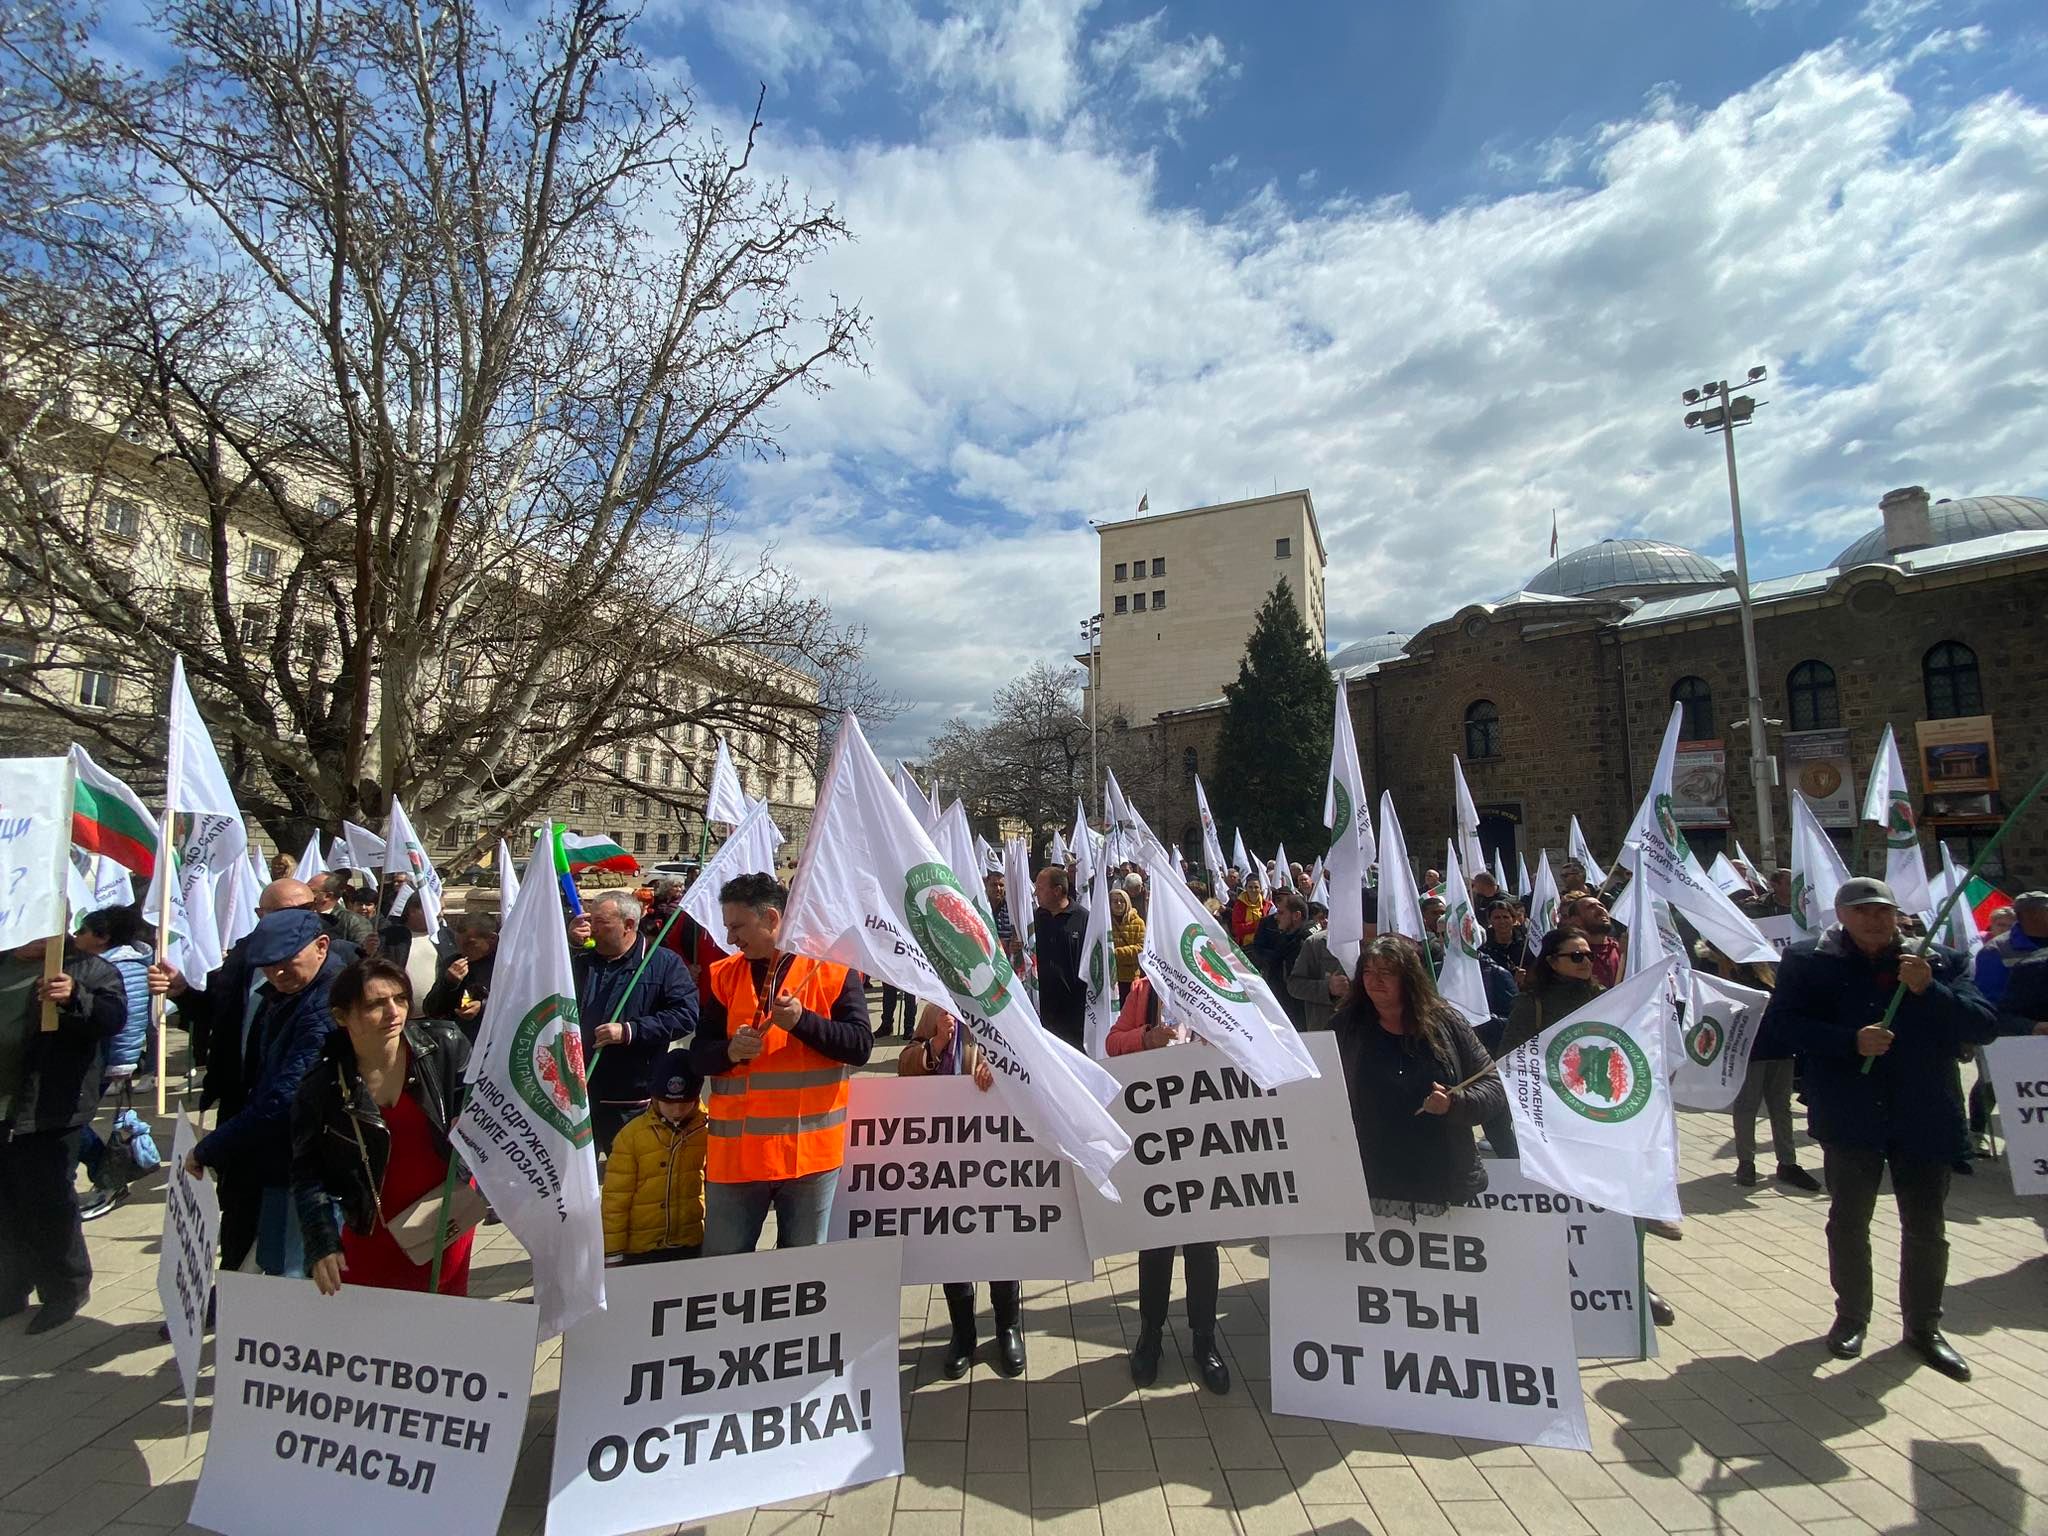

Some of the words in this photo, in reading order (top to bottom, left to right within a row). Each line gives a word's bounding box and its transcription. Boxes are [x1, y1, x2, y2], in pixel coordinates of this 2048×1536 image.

[1188, 980, 1242, 1028] СДРУЖЕНИЕ
[1196, 1002, 1235, 1033] ЛОЗАРИ
[971, 1040, 1031, 1085] ОЗАРИ
[1516, 1043, 1528, 1077] СКИТЕ
[1517, 1078, 1532, 1118] ЛОЗА
[1529, 1055, 1545, 1129] СДРУЖЕНИЕ
[465, 1097, 509, 1145] РСКИТЕ
[500, 1140, 551, 1199] ЛОЗАРИ
[850, 1115, 1035, 1147] ПУБЛИЧЕ
[1133, 1117, 1289, 1166] СРАМ!
[500, 1103, 562, 1194] СДРУЖЕНИЕ
[556, 1197, 568, 1223] НА
[848, 1159, 1061, 1193] ЛОЗАРСКИ
[1143, 1170, 1299, 1217] СРАМ!
[848, 1205, 1062, 1239] РЕГИСТЪР
[1345, 1229, 1488, 1273] КОЕВ
[651, 1280, 828, 1337] ГЕЧЕВ
[1357, 1284, 1480, 1334] ВЪН
[1570, 1290, 1634, 1311] ОСТ!
[234, 1337, 488, 1403] ЛОЗАРСТВОТО
[623, 1332, 845, 1406] ЛЪЖЕЦ
[1292, 1340, 1364, 1386] ОТ
[1383, 1349, 1559, 1409] ИАЛВ!
[242, 1378, 491, 1453] ПРИОРИТЕТЕН
[587, 1388, 873, 1483] ОСТАВКА!
[275, 1429, 437, 1495] ОТРАСЪЛ
